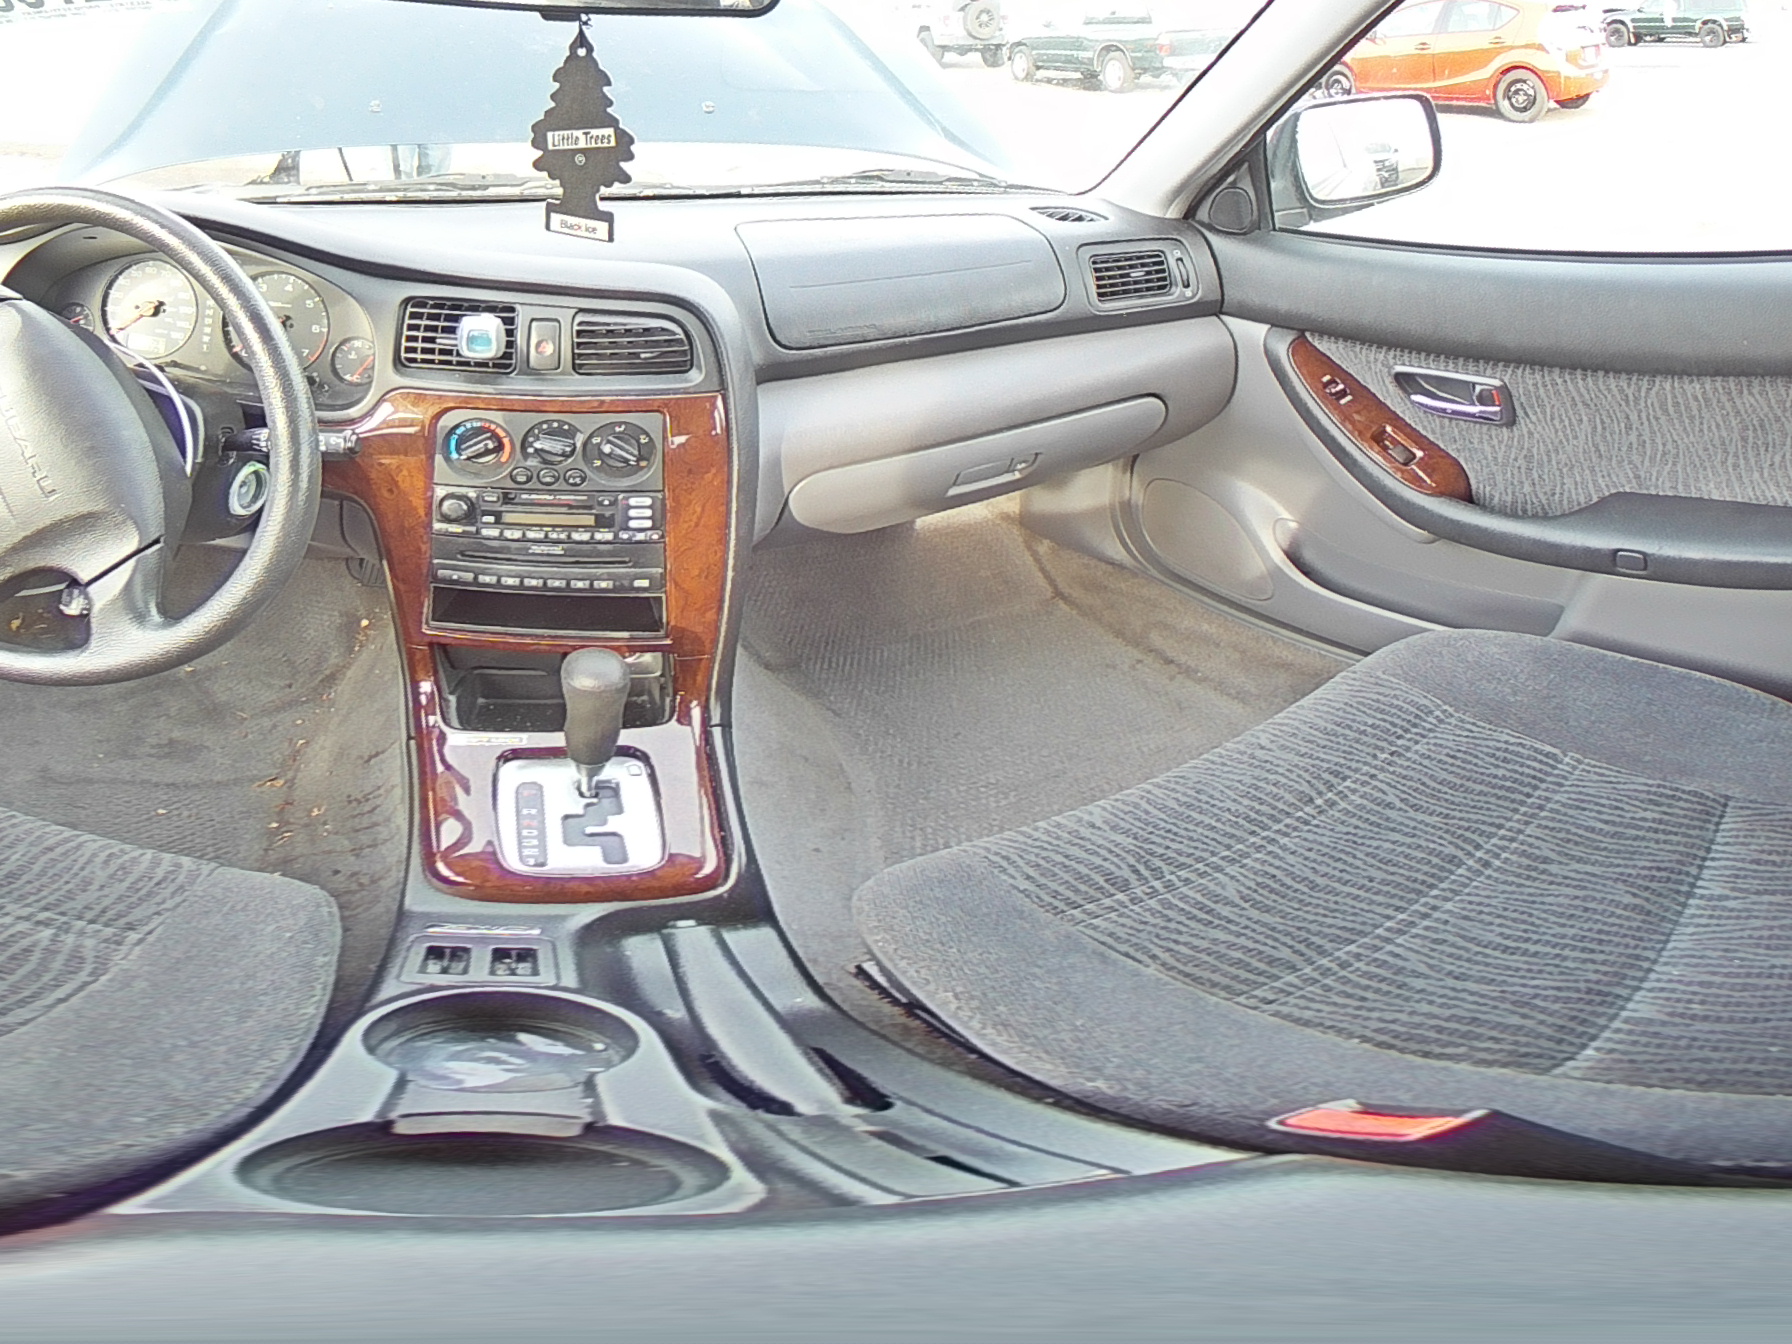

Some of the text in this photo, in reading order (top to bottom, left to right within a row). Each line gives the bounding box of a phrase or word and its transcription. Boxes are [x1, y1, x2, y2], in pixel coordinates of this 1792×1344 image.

[551, 131, 612, 148] Little Trees
[560, 219, 598, 235] Black Ice
[284, 283, 294, 292] 4
[305, 299, 314, 308] 5
[311, 324, 320, 333] 6
